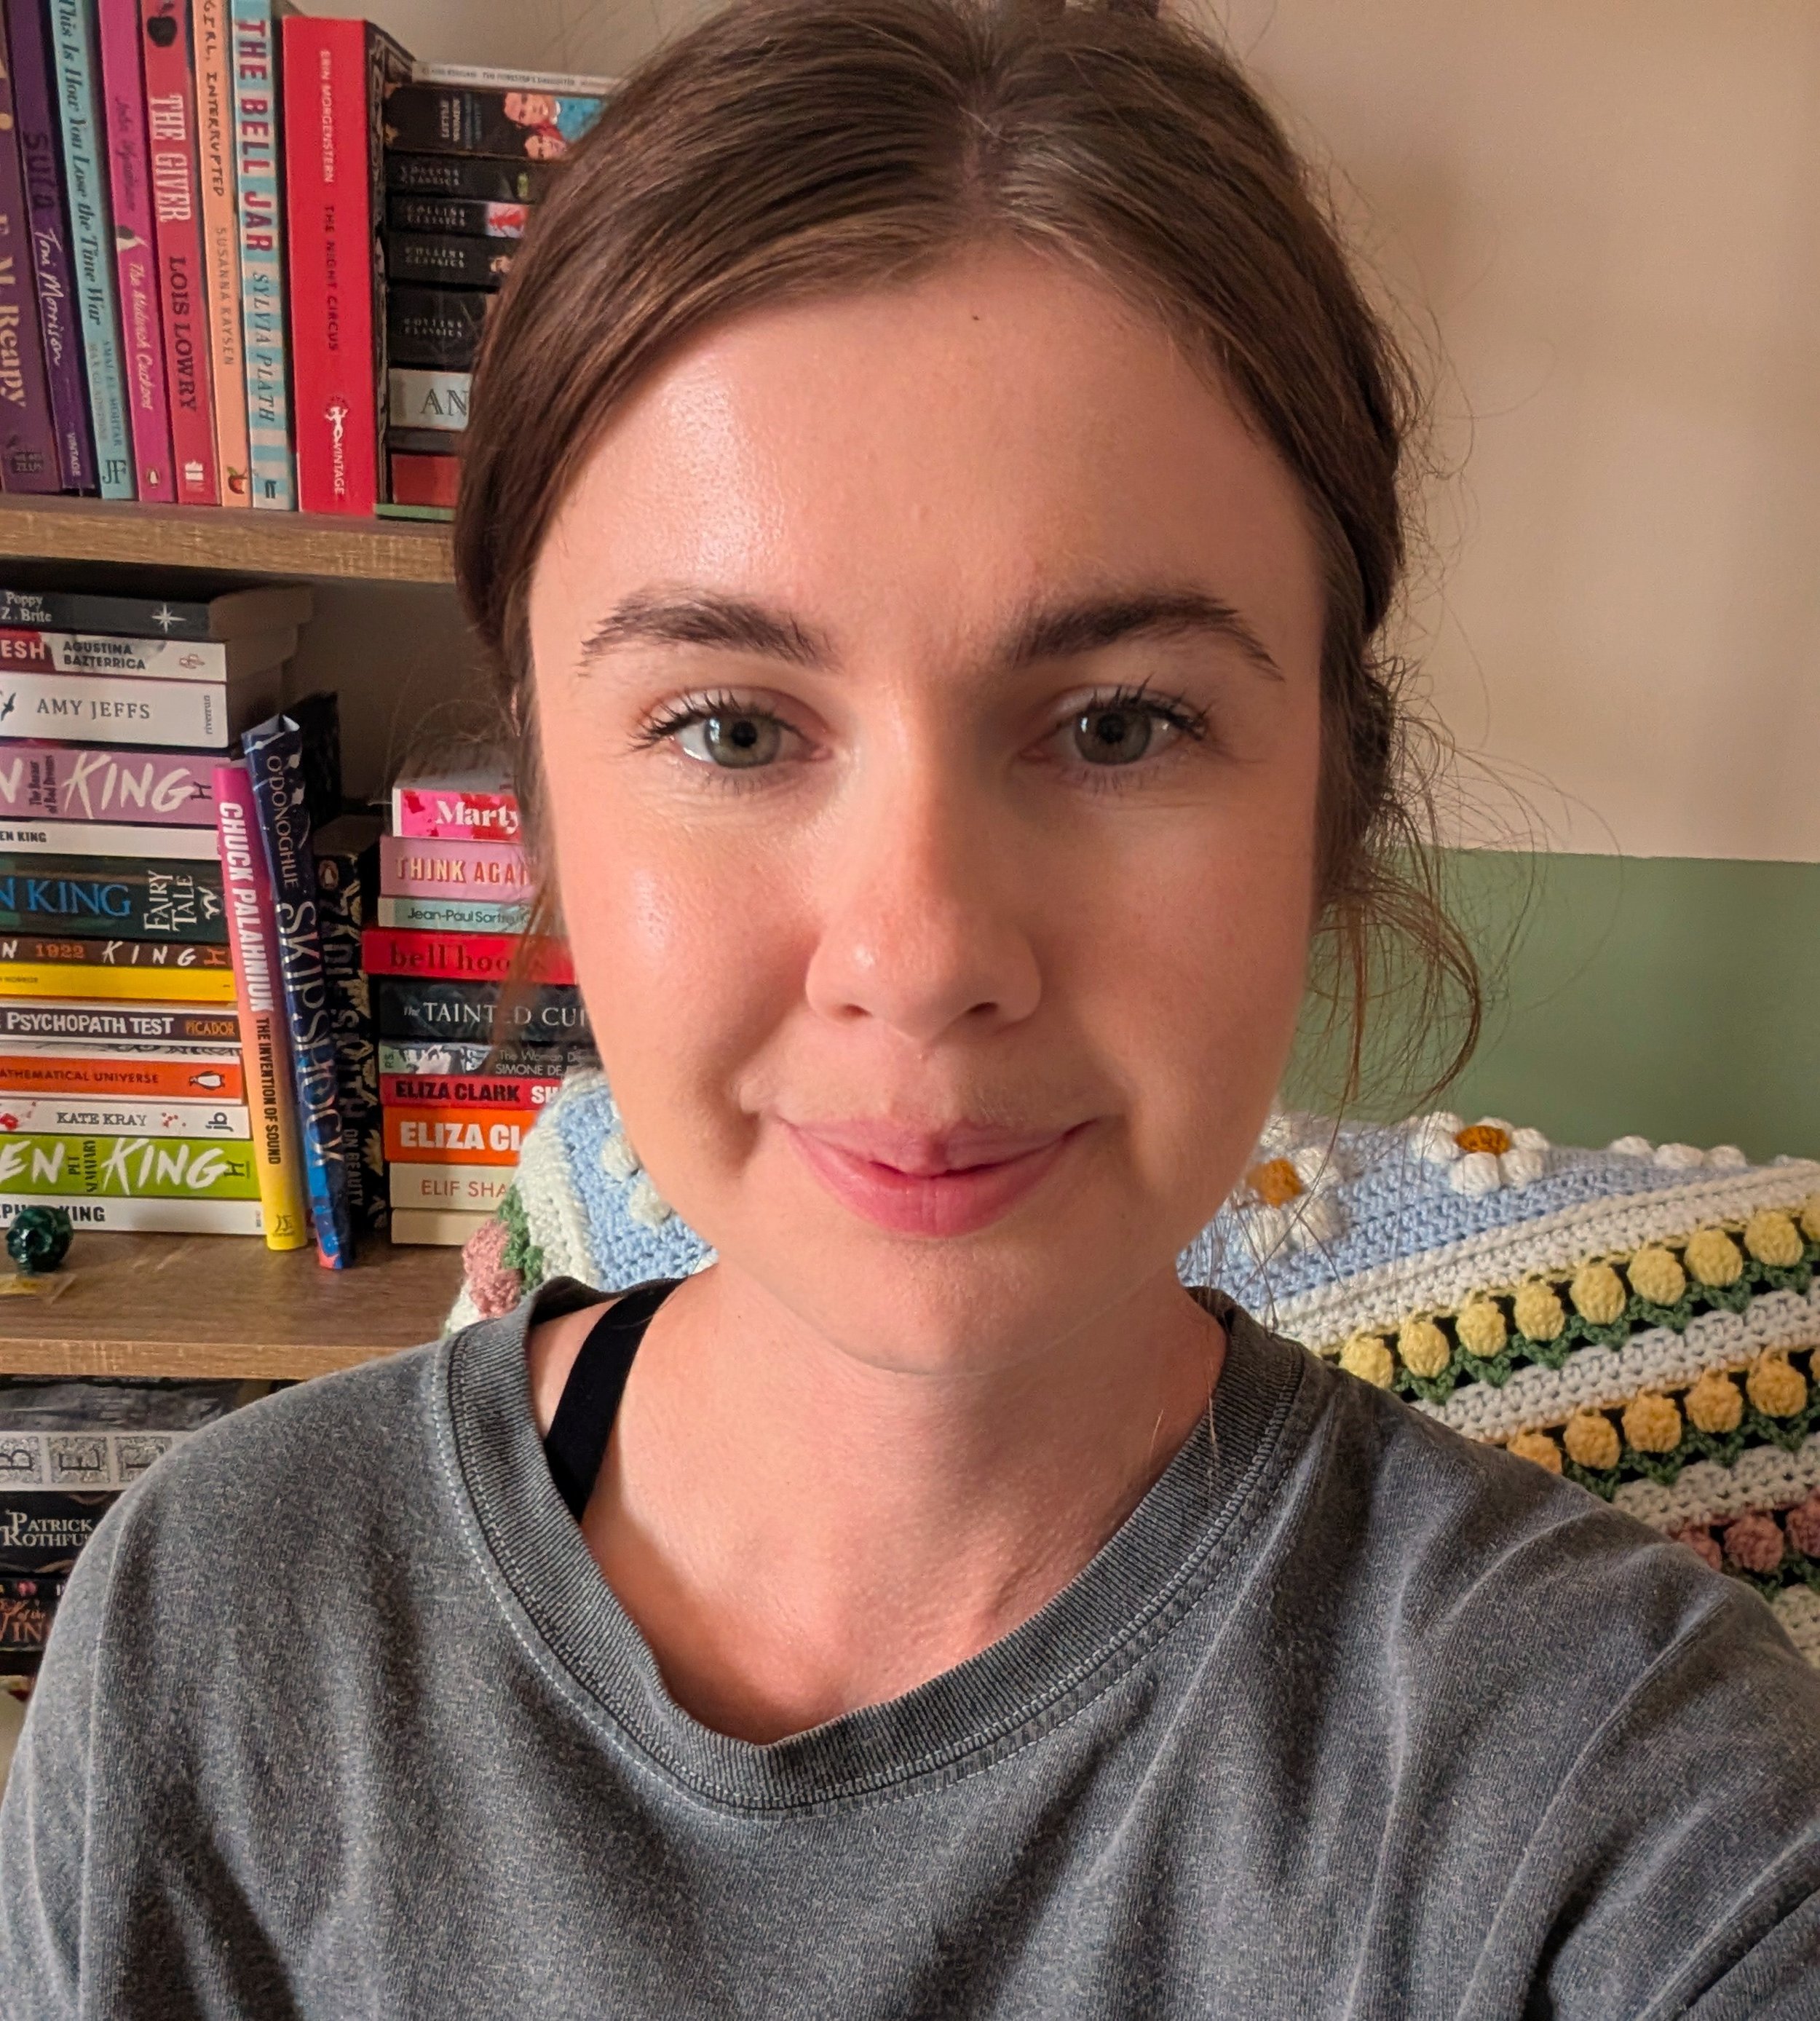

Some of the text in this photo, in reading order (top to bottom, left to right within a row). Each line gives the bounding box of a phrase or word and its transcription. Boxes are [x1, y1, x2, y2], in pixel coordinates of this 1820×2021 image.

[206, 73, 225, 197] INTERRUPTED
[237, 20, 273, 252] THE BELL JAR
[59, 0, 103, 325] This Is How You Lose the Time War
[150, 93, 191, 222] THE GIVER
[130, 263, 144, 286] The
[325, 205, 339, 351] THE NIGHT CIRCUS
[34, 228, 64, 366] Toni Morrison
[216, 228, 234, 365] SUSANNA KAYSEN
[170, 257, 197, 411] LOIS LOWRY
[253, 272, 276, 422] SYLVIA PLATH
[68, 432, 81, 476] VINTAGE
[333, 443, 346, 496] VINTAGE
[1, 607, 52, 623] Z. Brite
[5, 591, 43, 609] Poppy
[0, 640, 45, 660] ESH
[63, 641, 132, 655] AGUSTINA
[63, 654, 146, 670] BAZTERRICA
[37, 698, 151, 720] AMY JEFFS
[29, 791, 42, 805] The
[43, 788, 57, 804] Bad
[61, 751, 197, 820] KING
[266, 755, 300, 889] O'DONOGHUE
[436, 800, 518, 834] Marty
[17, 831, 47, 842] KING
[396, 855, 528, 886] THINK AGAI
[27, 879, 131, 917] KING
[143, 870, 173, 931] FAIRY
[171, 874, 197, 932] TALE
[408, 907, 473, 922] Jean-Paul
[35, 944, 85, 960] 1922
[102, 941, 197, 967] KING
[389, 942, 510, 972] bell hoo
[219, 802, 281, 1166] CHUCK PALAHNIUK THE INVENTION OF SOUND
[7, 1012, 234, 1037] PSYCHOPATH TEST PICADOR
[404, 1006, 420, 1017] The
[422, 1002, 531, 1024] TAINTD
[276, 901, 344, 1165] SKIPSHOCK
[94, 1072, 159, 1084] UNIVERSE
[495, 1064, 562, 1075] SIMONE DE
[395, 1080, 450, 1100] ELIZA
[456, 1082, 521, 1103] CLARK
[56, 1112, 146, 1127] KATE KRAY
[400, 1121, 486, 1151] ELIZA
[0, 1140, 66, 1184] EN
[100, 1136, 229, 1195] KING
[343, 1129, 363, 1206] ON BEAUTY
[422, 1179, 507, 1198] ELIF SHA
[5, 1509, 94, 1532] PATRICK
